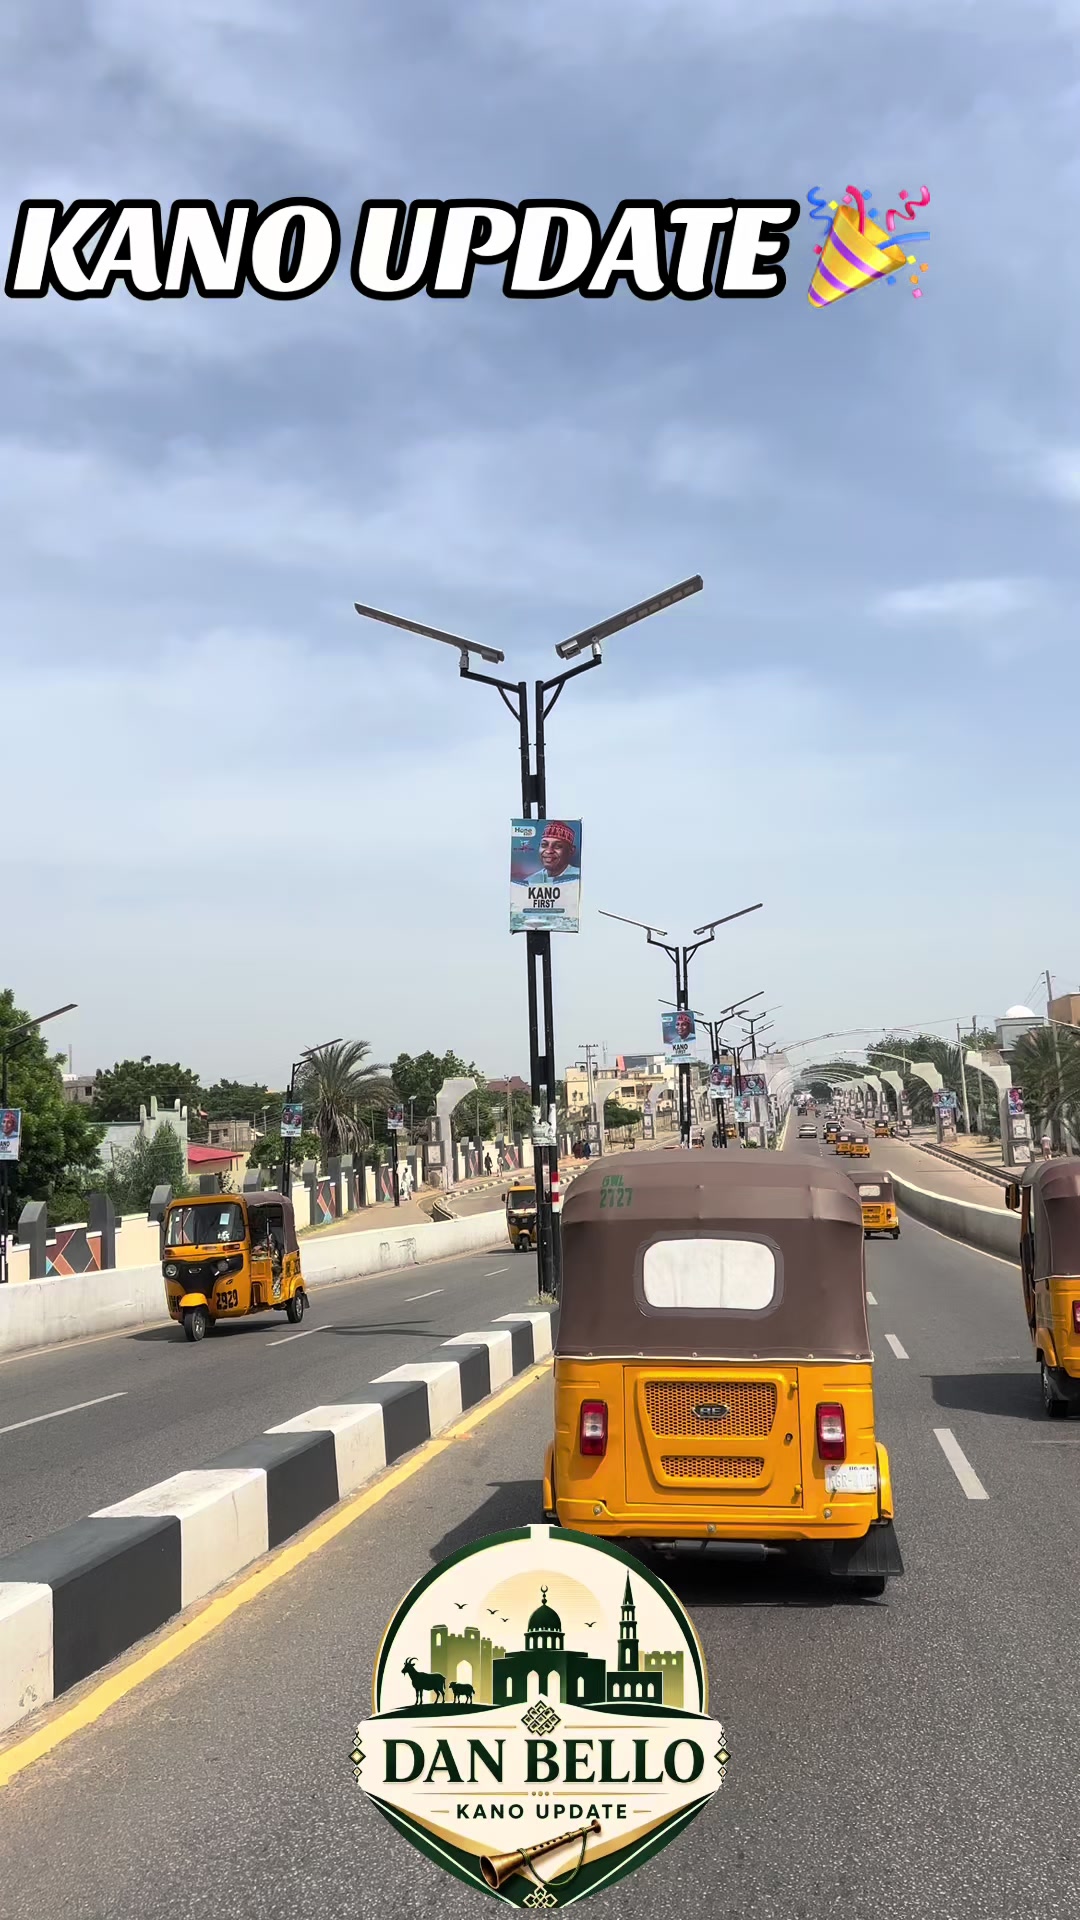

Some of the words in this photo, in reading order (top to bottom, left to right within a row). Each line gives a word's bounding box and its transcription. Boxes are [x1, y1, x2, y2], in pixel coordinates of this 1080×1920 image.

[528, 887, 561, 900] KANO
[533, 900, 555, 908] FIRST
[600, 1187, 632, 1208] 2727
[216, 1289, 238, 1310] 2929
